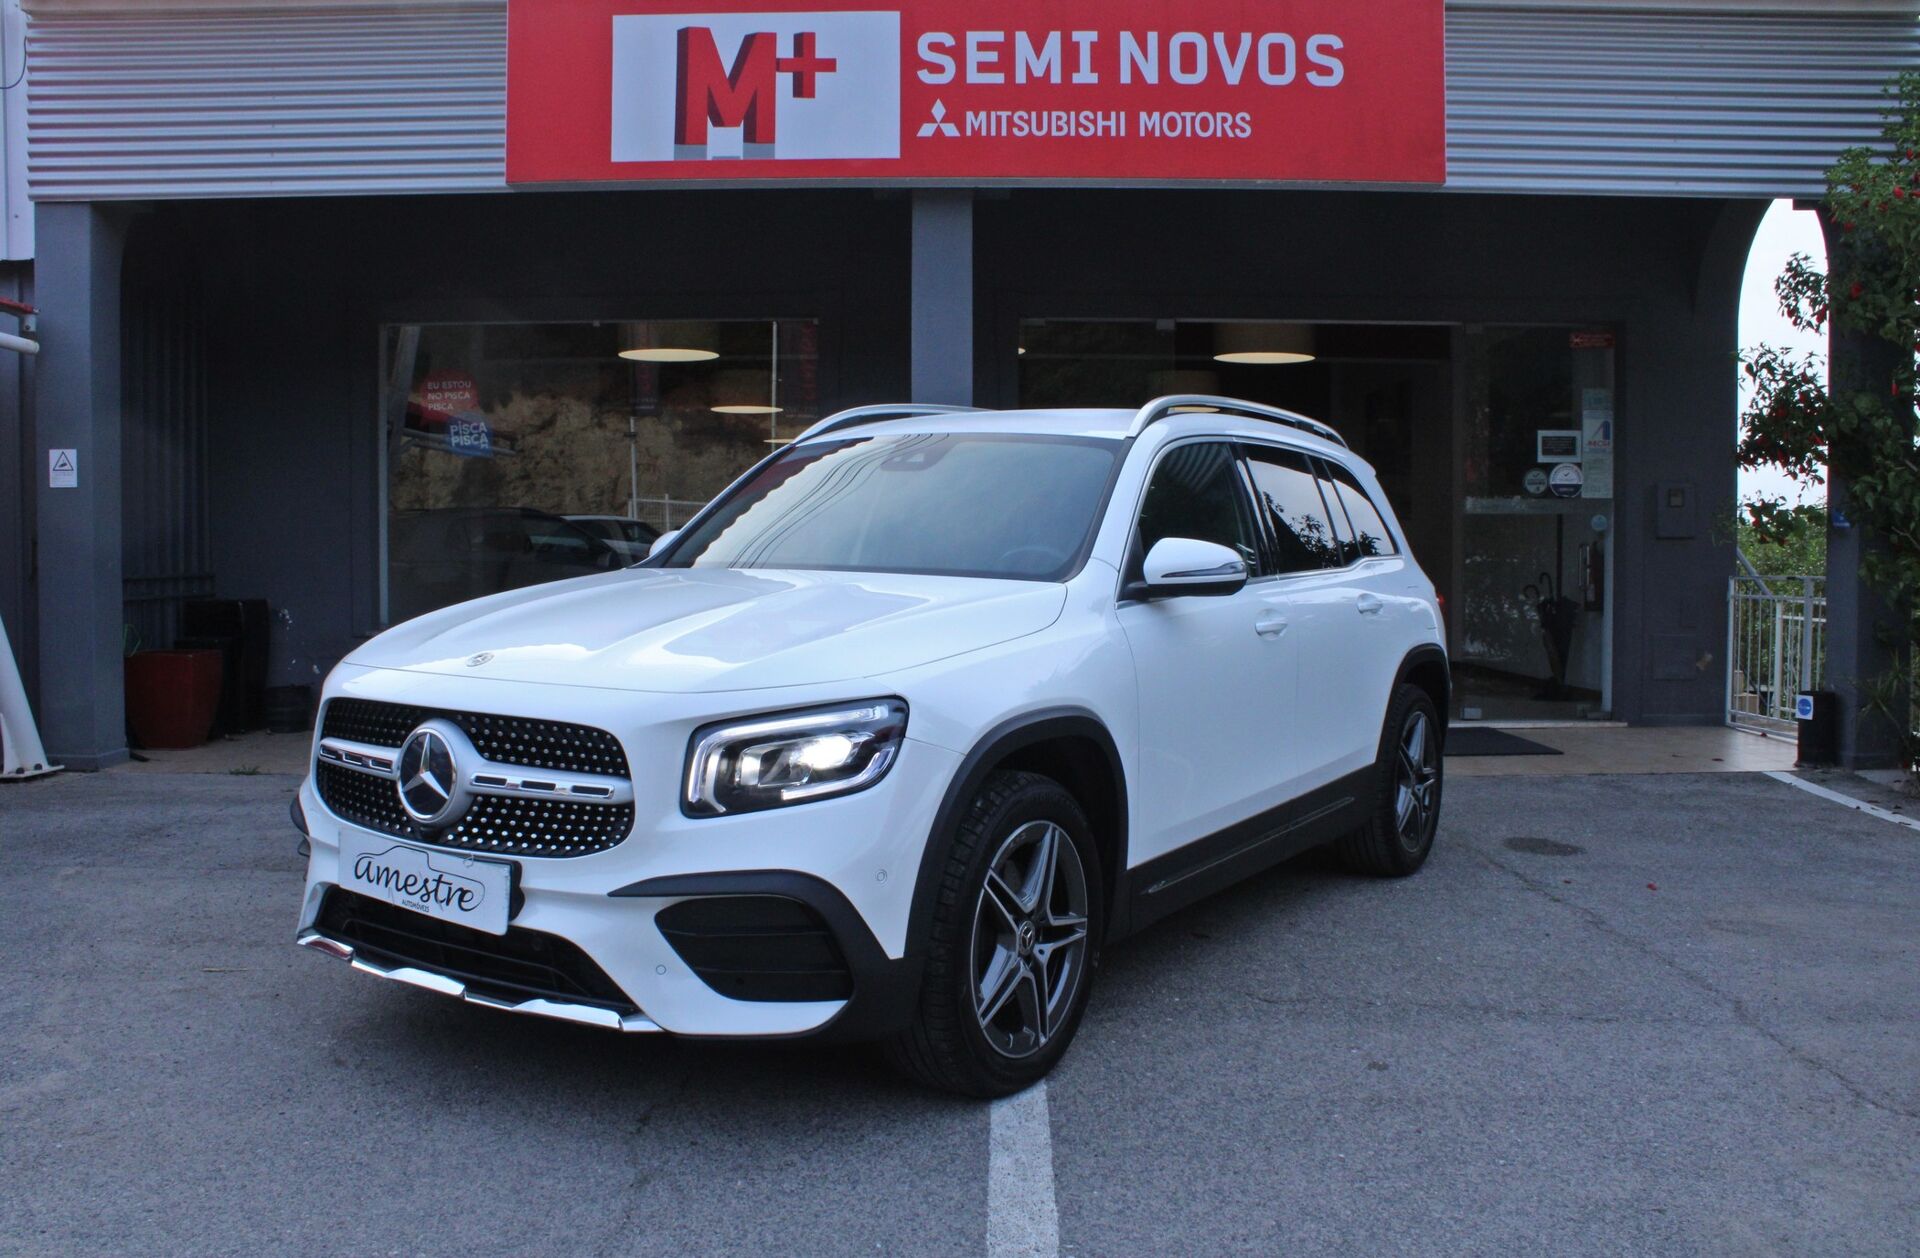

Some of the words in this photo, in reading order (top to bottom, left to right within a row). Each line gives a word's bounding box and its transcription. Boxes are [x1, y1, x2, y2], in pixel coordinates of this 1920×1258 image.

[916, 30, 1099, 85] SEMI
[1119, 30, 1345, 87] NOVOS
[674, 27, 837, 146] M+
[965, 110, 1126, 138] MITSUBISHI
[1139, 110, 1252, 138] MOTORS
[428, 382, 440, 390] EU
[441, 381, 472, 389] ESTOU
[444, 392, 471, 400] PISCA
[428, 402, 454, 411] PISCA
[450, 421, 488, 435] PISCA
[451, 433, 489, 447] PISCA
[354, 855, 475, 912] amestre
